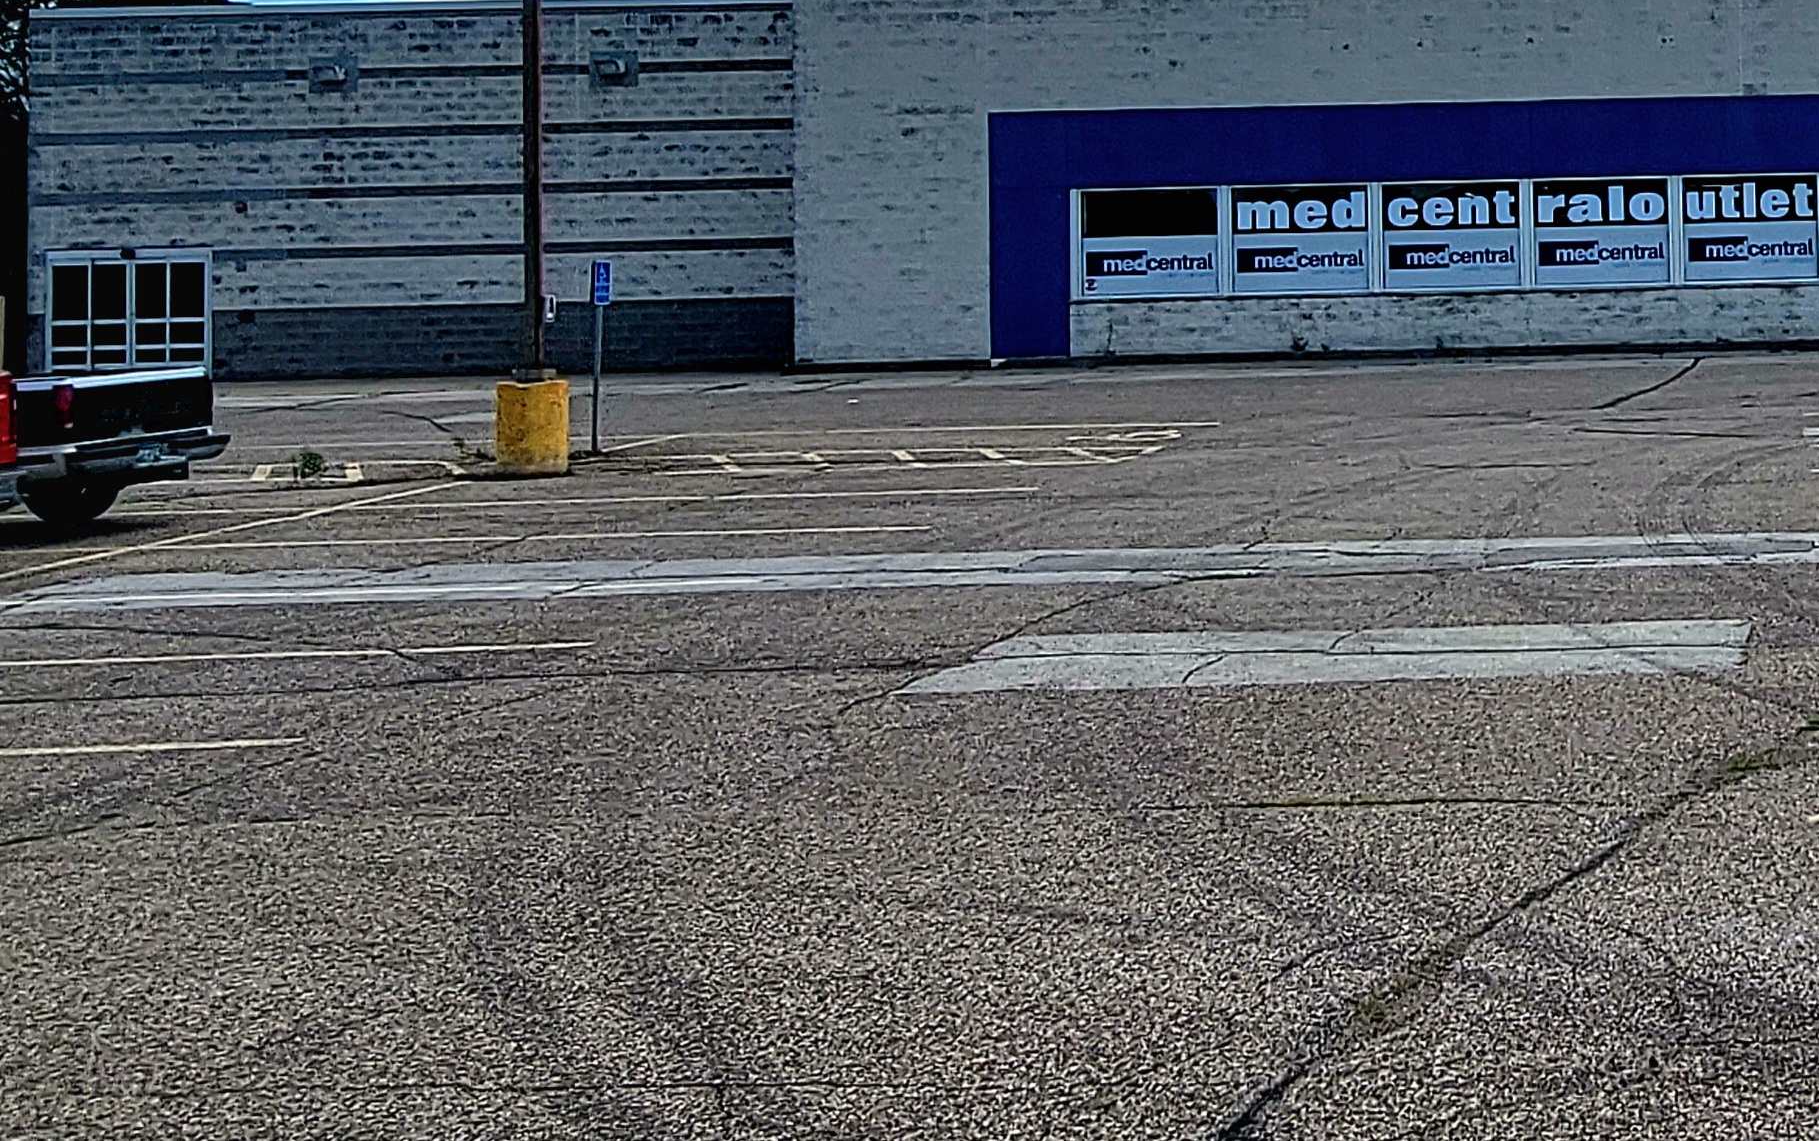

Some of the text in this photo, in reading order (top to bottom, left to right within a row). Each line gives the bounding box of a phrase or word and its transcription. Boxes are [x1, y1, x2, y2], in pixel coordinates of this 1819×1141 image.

[1237, 191, 1366, 230] med
[1387, 190, 1516, 227] cent
[1537, 185, 1665, 223] ralo
[1685, 182, 1814, 220] utlet
[1406, 245, 1516, 265] medcentral
[1555, 242, 1665, 262] medcentral
[1705, 238, 1814, 258] medcentral
[1103, 252, 1214, 272] medcentral
[1253, 249, 1365, 269] medcentral
